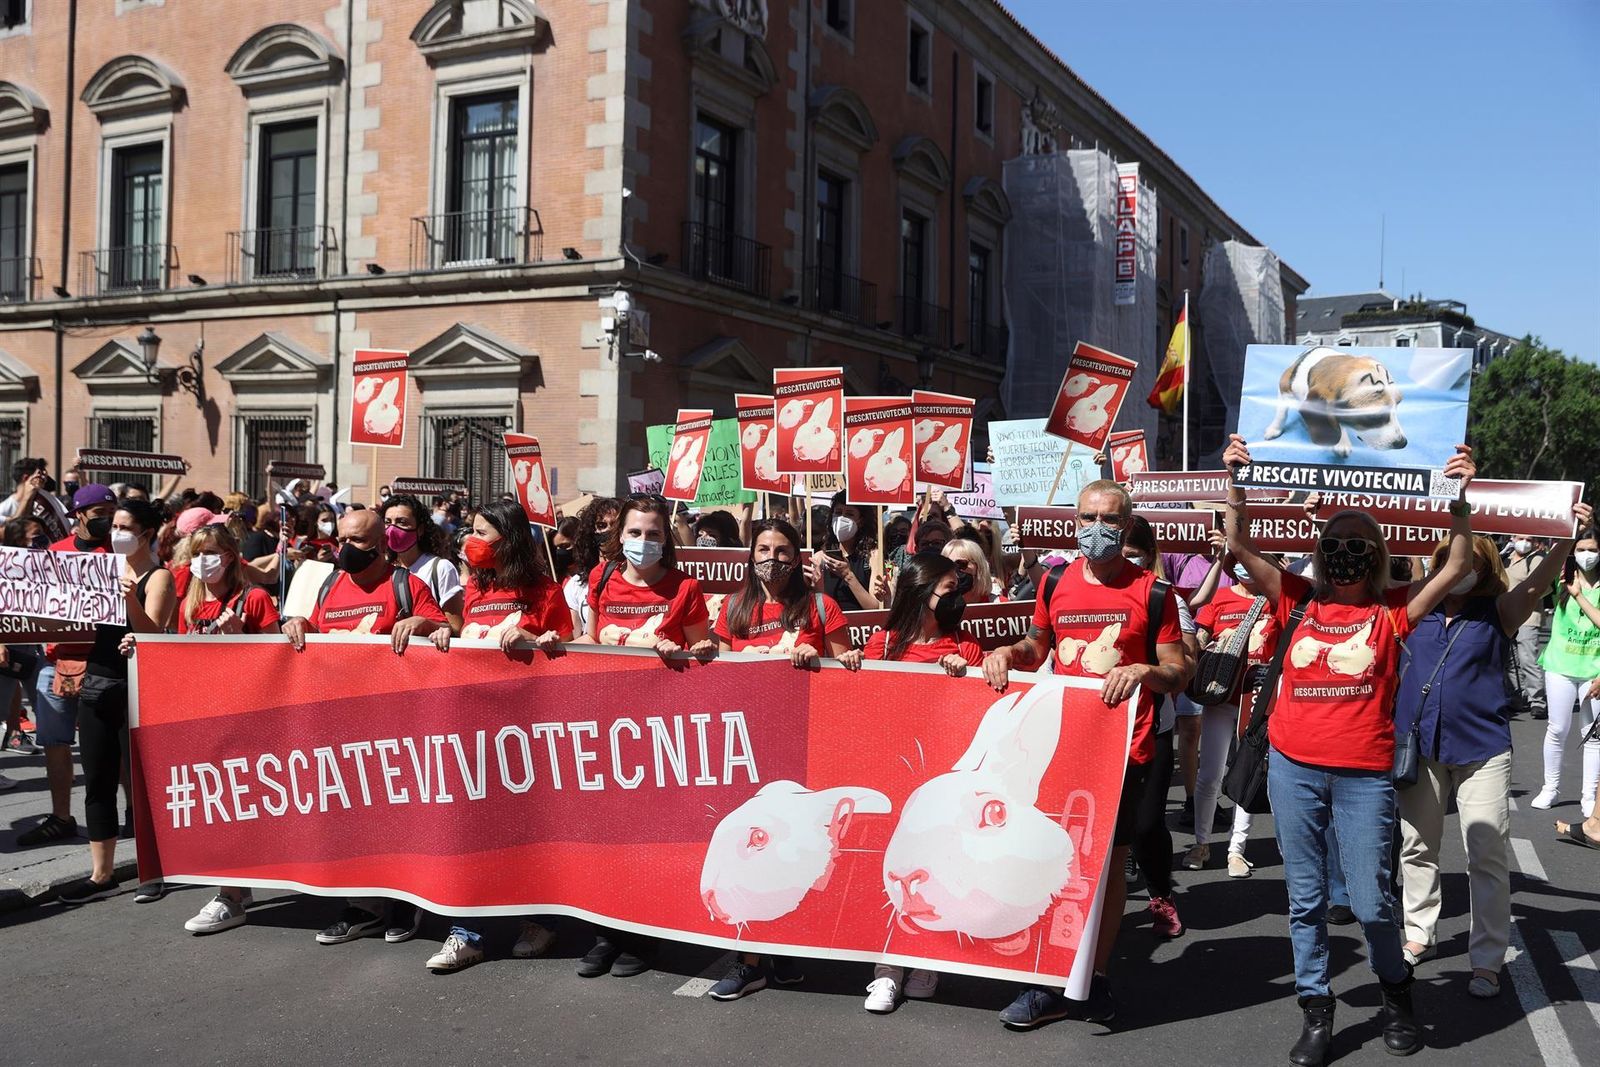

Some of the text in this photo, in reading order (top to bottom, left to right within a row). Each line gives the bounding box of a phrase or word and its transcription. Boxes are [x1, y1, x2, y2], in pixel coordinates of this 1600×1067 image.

[1073, 358, 1132, 377] #RESCATEVIVOTECNIA
[776, 378, 841, 395] #RESCATEVIVOTECNIA
[846, 407, 912, 424] #RESCATEVIVOTECNIA
[80, 455, 184, 470] #RESCATEVIVOTECNIA
[1252, 466, 1317, 485] RESCATE
[1322, 469, 1425, 492] VIVOTECNIA
[606, 604, 669, 614] #RESCATEVIVOTECNIA
[1058, 613, 1127, 624] #RESCATEVIVOTECNIA
[165, 711, 760, 830] #RESCATEVIVOTECNIA
